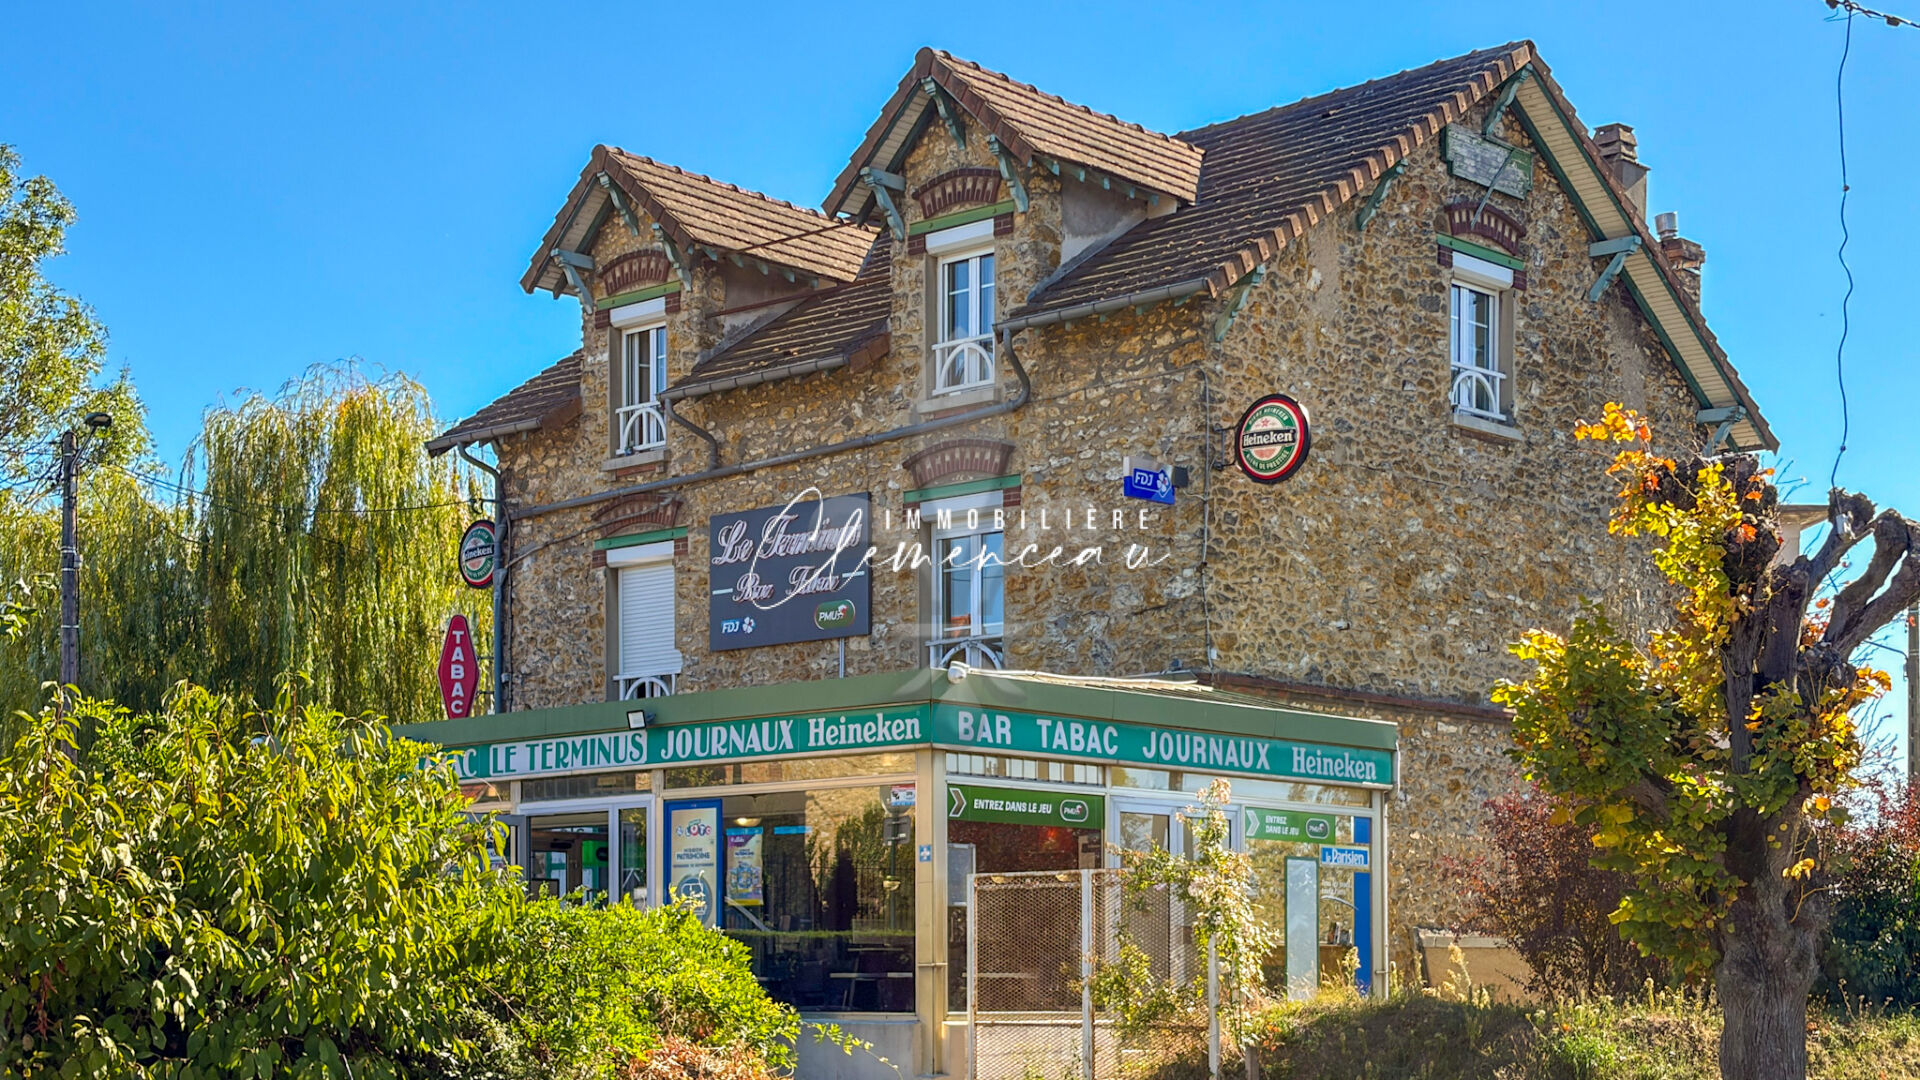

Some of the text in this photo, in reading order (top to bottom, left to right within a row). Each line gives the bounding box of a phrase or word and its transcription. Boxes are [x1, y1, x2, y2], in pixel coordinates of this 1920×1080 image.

[1243, 431, 1293, 447] Heineken
[1135, 471, 1154, 487] FDJ
[711, 519, 754, 565] Le
[732, 572, 775, 602] Bar
[818, 611, 838, 622] PMU
[721, 621, 740, 634] FDJ
[450, 630, 465, 714] TABAC
[492, 745, 517, 774] LE
[525, 732, 645, 772] TERMINUS
[661, 719, 794, 760] JOURNAUX
[808, 712, 922, 747] Heineken
[958, 710, 1377, 780] BAR TABAC JOURNAUX Heineken
[973, 798, 1053, 814] ENTREZ DANS LE JEU
[1265, 815, 1287, 824] ENTREZ
[1265, 825, 1281, 834] DANS
[1282, 826, 1289, 835] LE
[1332, 847, 1365, 865] Parisien
